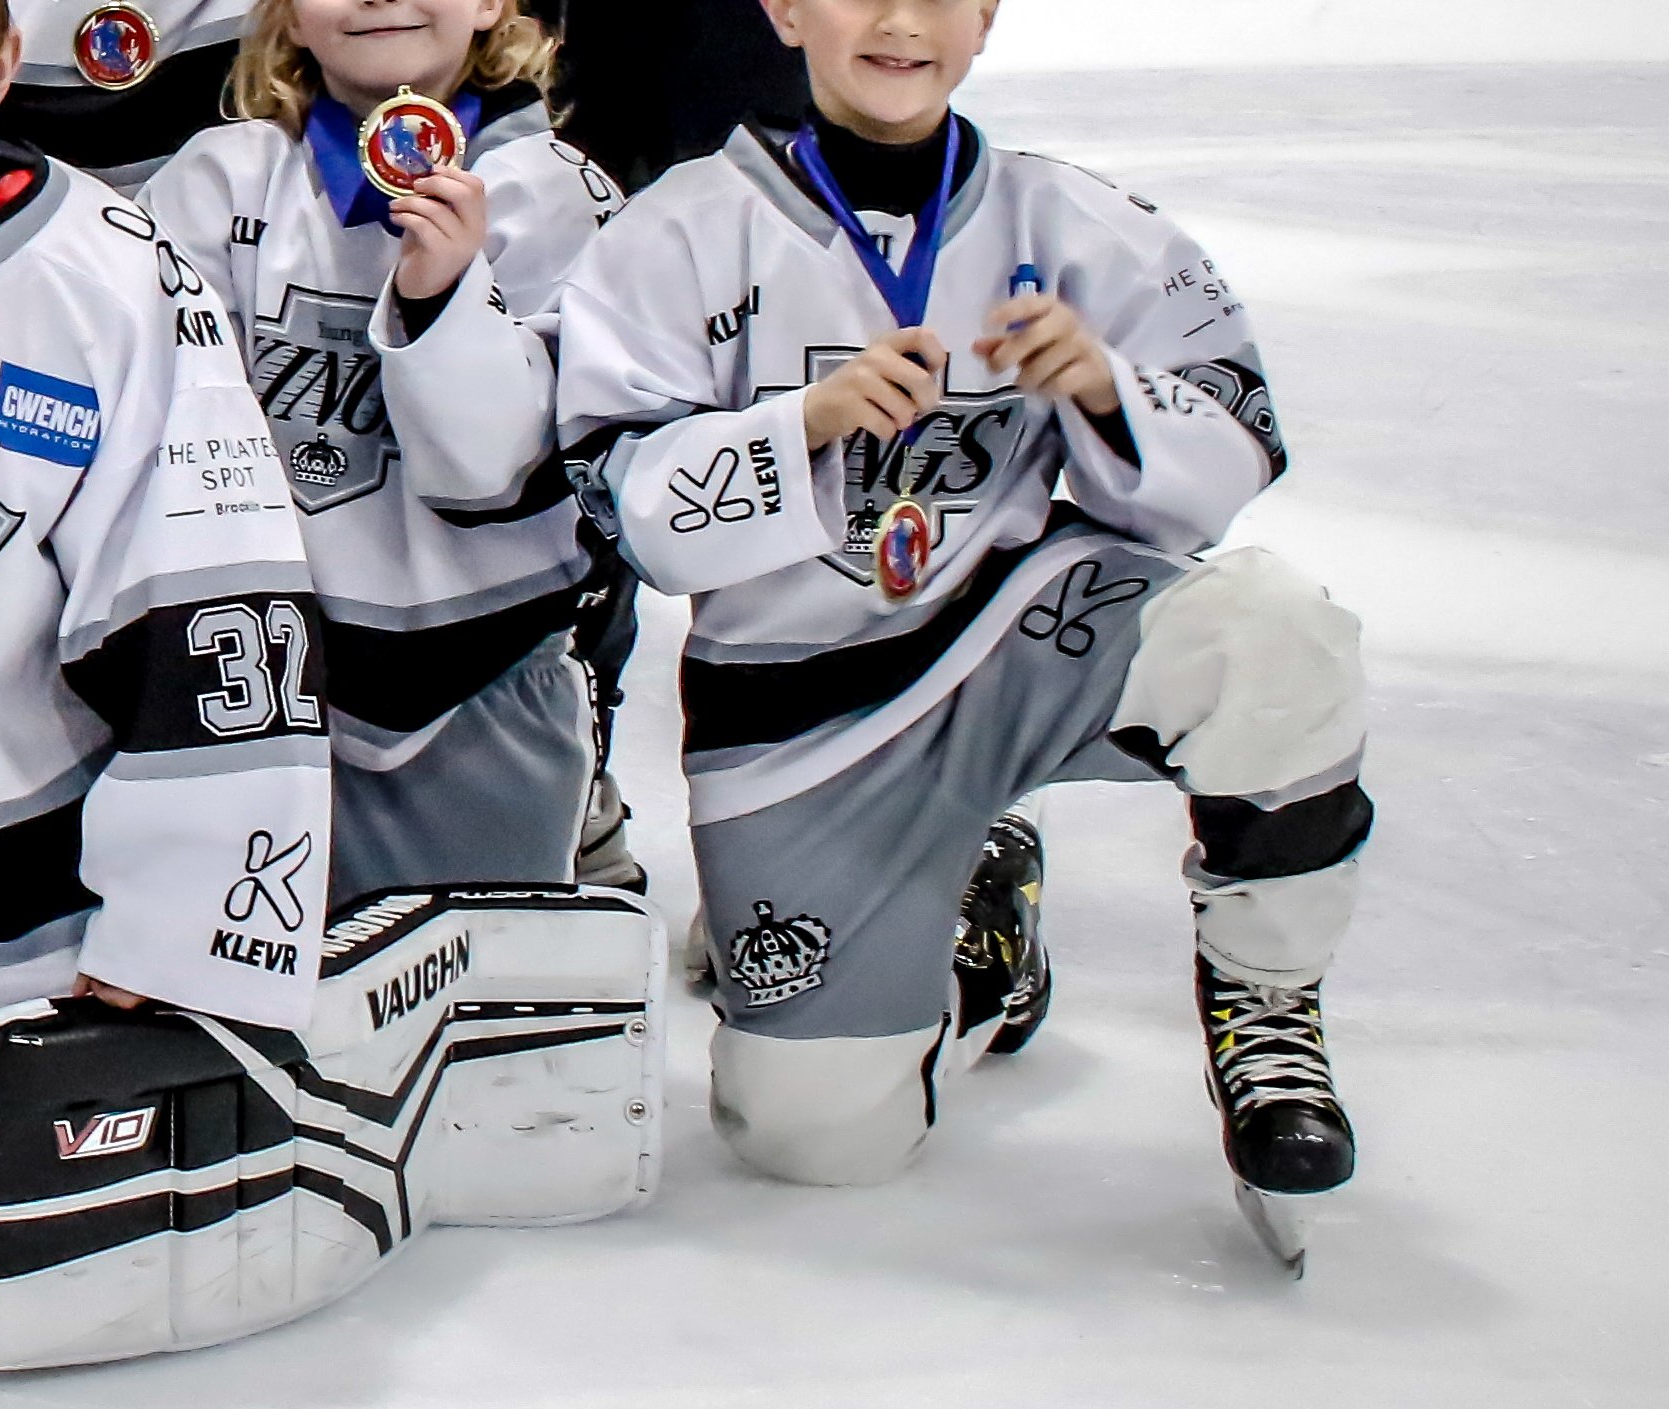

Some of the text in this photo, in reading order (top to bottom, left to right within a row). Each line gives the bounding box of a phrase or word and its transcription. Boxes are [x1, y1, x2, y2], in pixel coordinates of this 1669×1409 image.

[1, 385, 100, 440] CWENCH
[156, 442, 196, 468] THE
[202, 466, 255, 491] SPOT
[747, 435, 782, 516] KLEVR
[189, 601, 320, 737] 32
[210, 928, 298, 976] KLEVR
[364, 929, 471, 1032] VAUGHN
